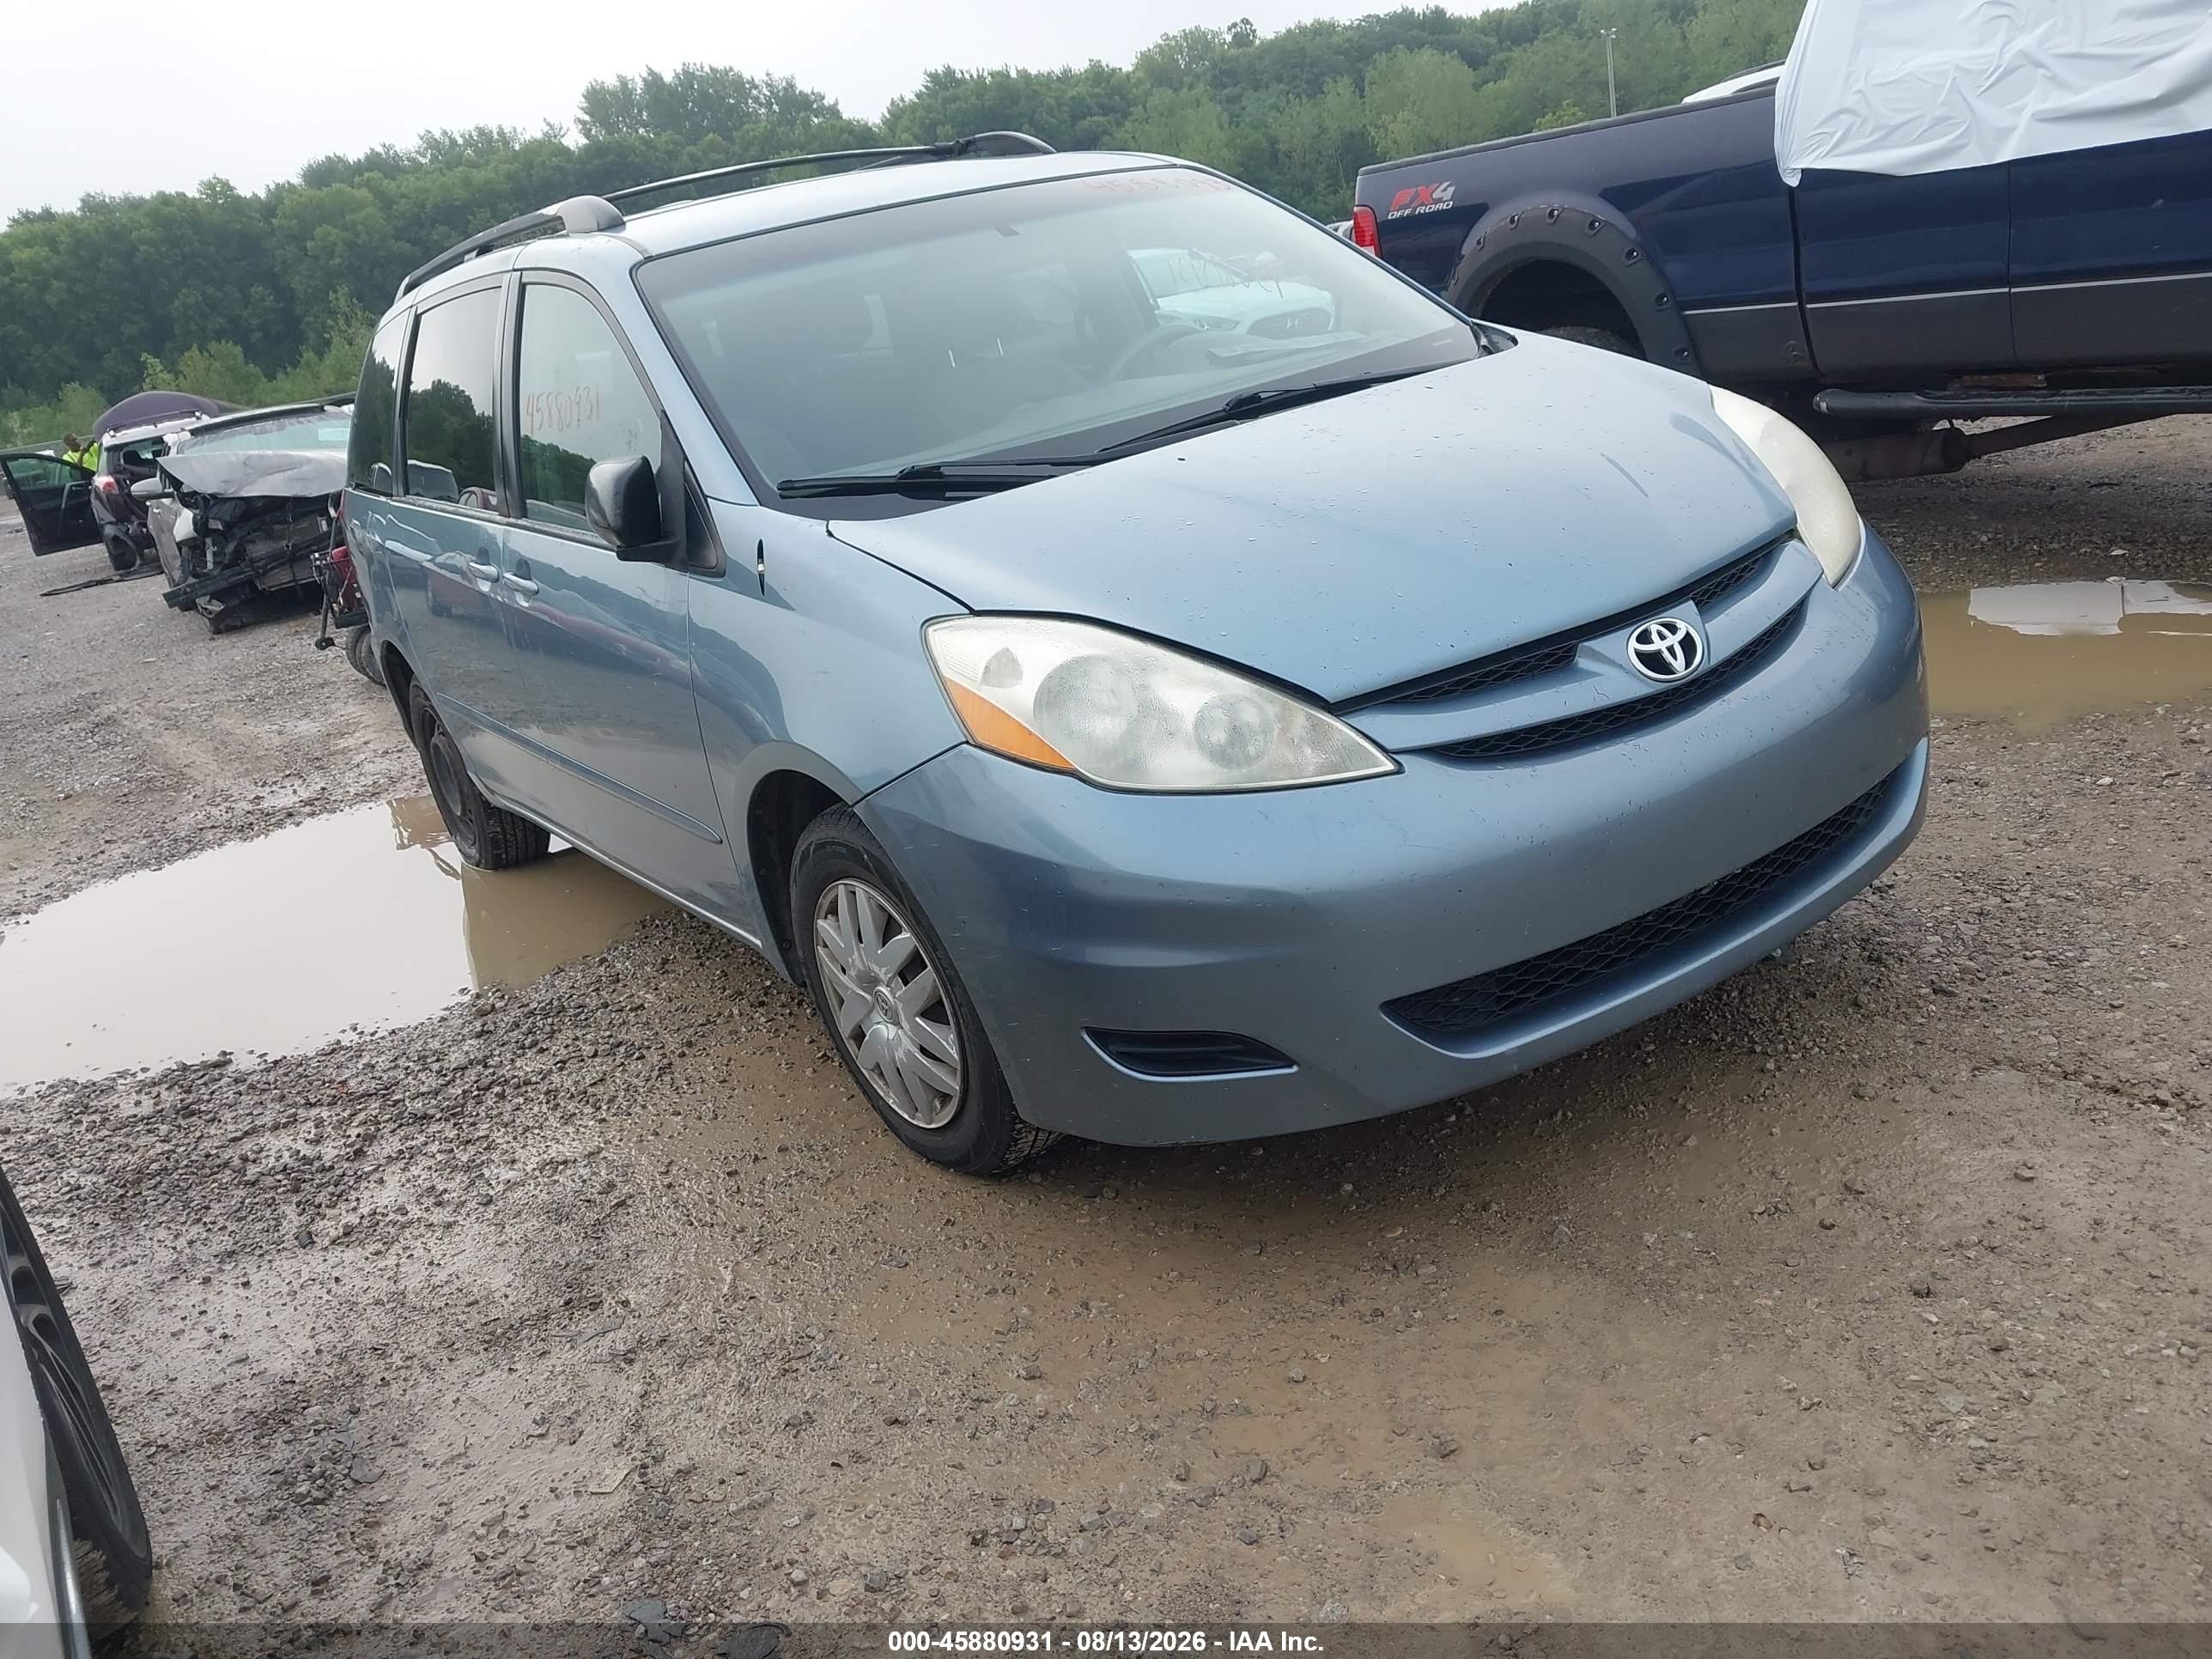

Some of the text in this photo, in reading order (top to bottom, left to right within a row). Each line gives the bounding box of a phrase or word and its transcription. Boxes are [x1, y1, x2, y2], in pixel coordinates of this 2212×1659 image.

[1387, 200, 1454, 220] OFF ROAD
[1389, 180, 1456, 211] FX4
[526, 382, 600, 434] 45880931
